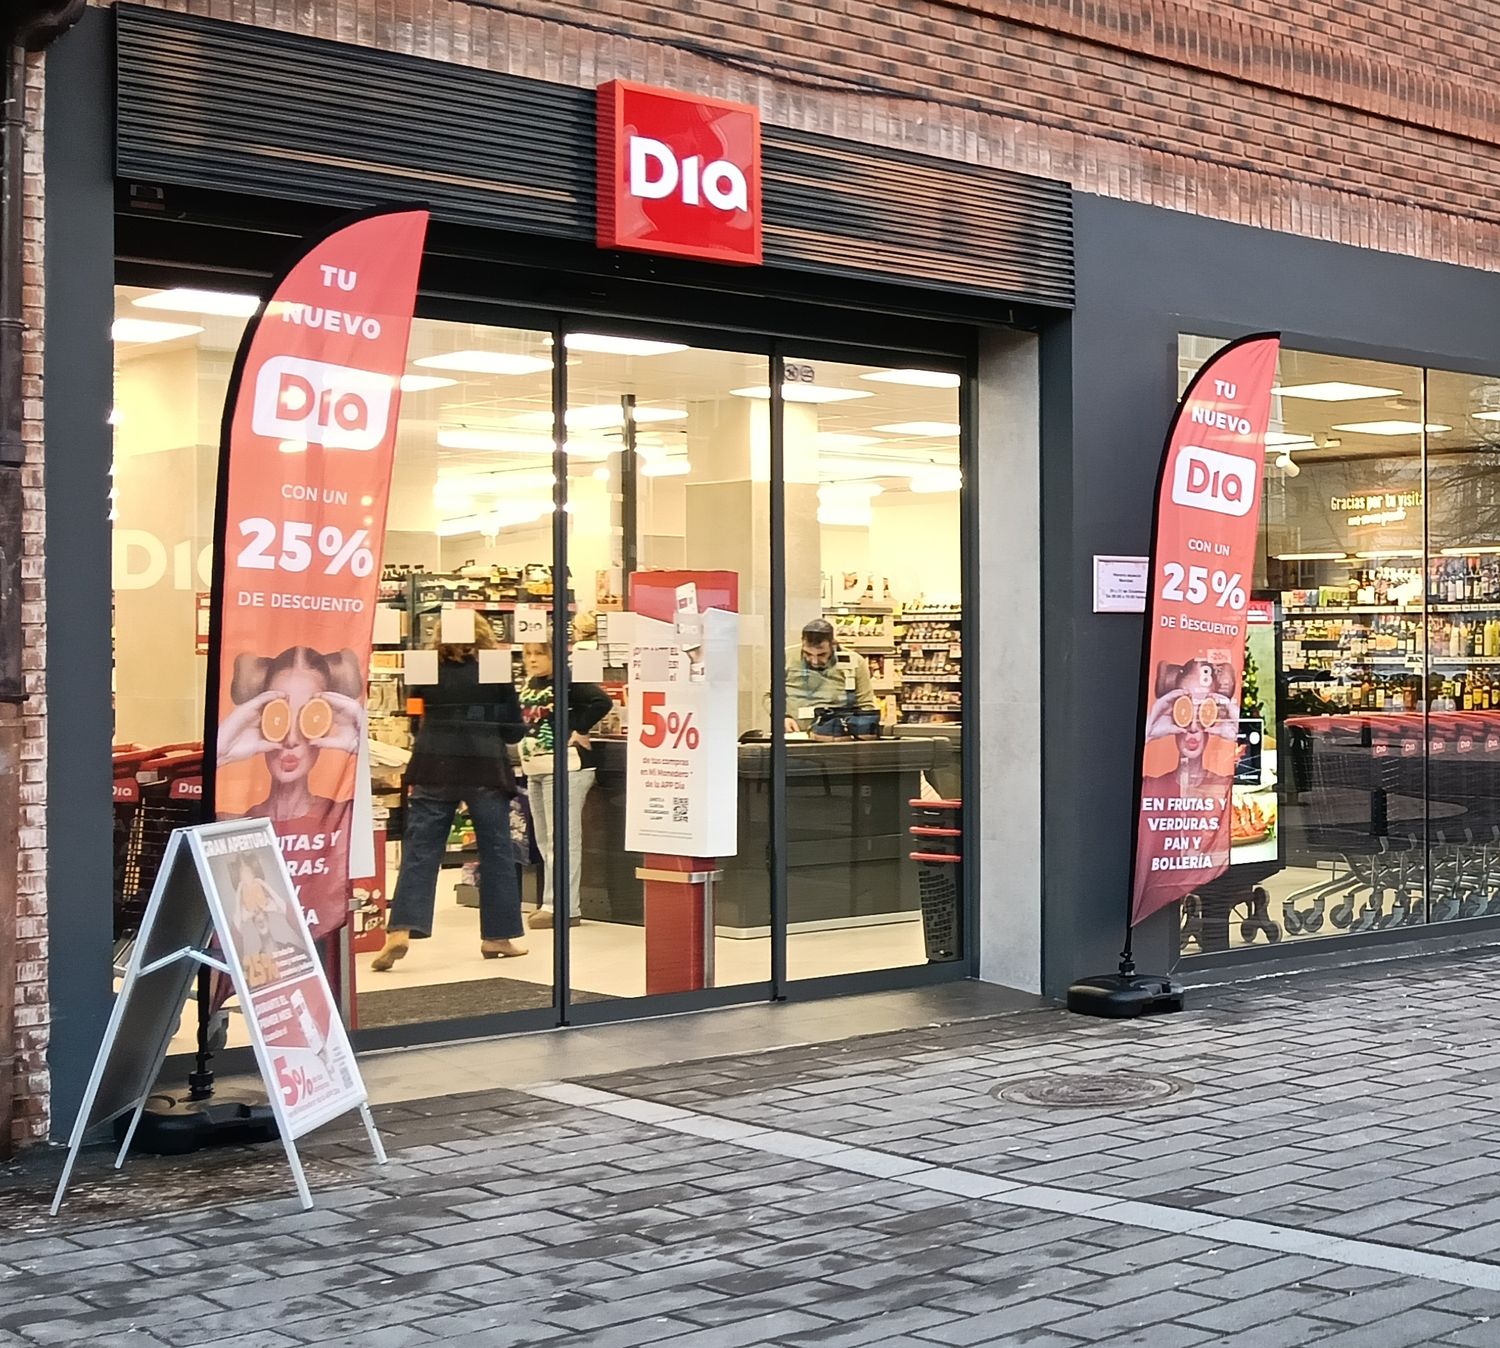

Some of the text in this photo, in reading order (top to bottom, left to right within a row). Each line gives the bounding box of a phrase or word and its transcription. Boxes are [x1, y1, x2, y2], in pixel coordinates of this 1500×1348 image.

[630, 135, 748, 213] Dia
[320, 264, 357, 291] TU
[282, 303, 381, 340] NUEVO
[1214, 379, 1236, 399] TU
[276, 372, 368, 432] Dia
[1192, 406, 1251, 435] NUEVO
[1187, 458, 1242, 503] Dia
[281, 483, 348, 505] CON UN
[1330, 494, 1365, 510] Gracias
[1366, 495, 1383, 511] por
[1385, 493, 1397, 508] tu
[237, 517, 374, 578] 25%
[1188, 538, 1230, 556] CON UN
[1161, 562, 1246, 610] 25%
[238, 591, 364, 613] DE DESCUENTO
[1161, 615, 1239, 636] DE DESCUENTO
[639, 691, 700, 750] 5%
[1142, 797, 1228, 811] EN FRUTAS Y
[1147, 817, 1220, 831] VERDURAS,
[276, 829, 342, 852] UTAS Y
[1164, 836, 1202, 850] PAN Y
[1151, 853, 1213, 871] BOLLERÍA
[273, 1055, 315, 1108] 5%
